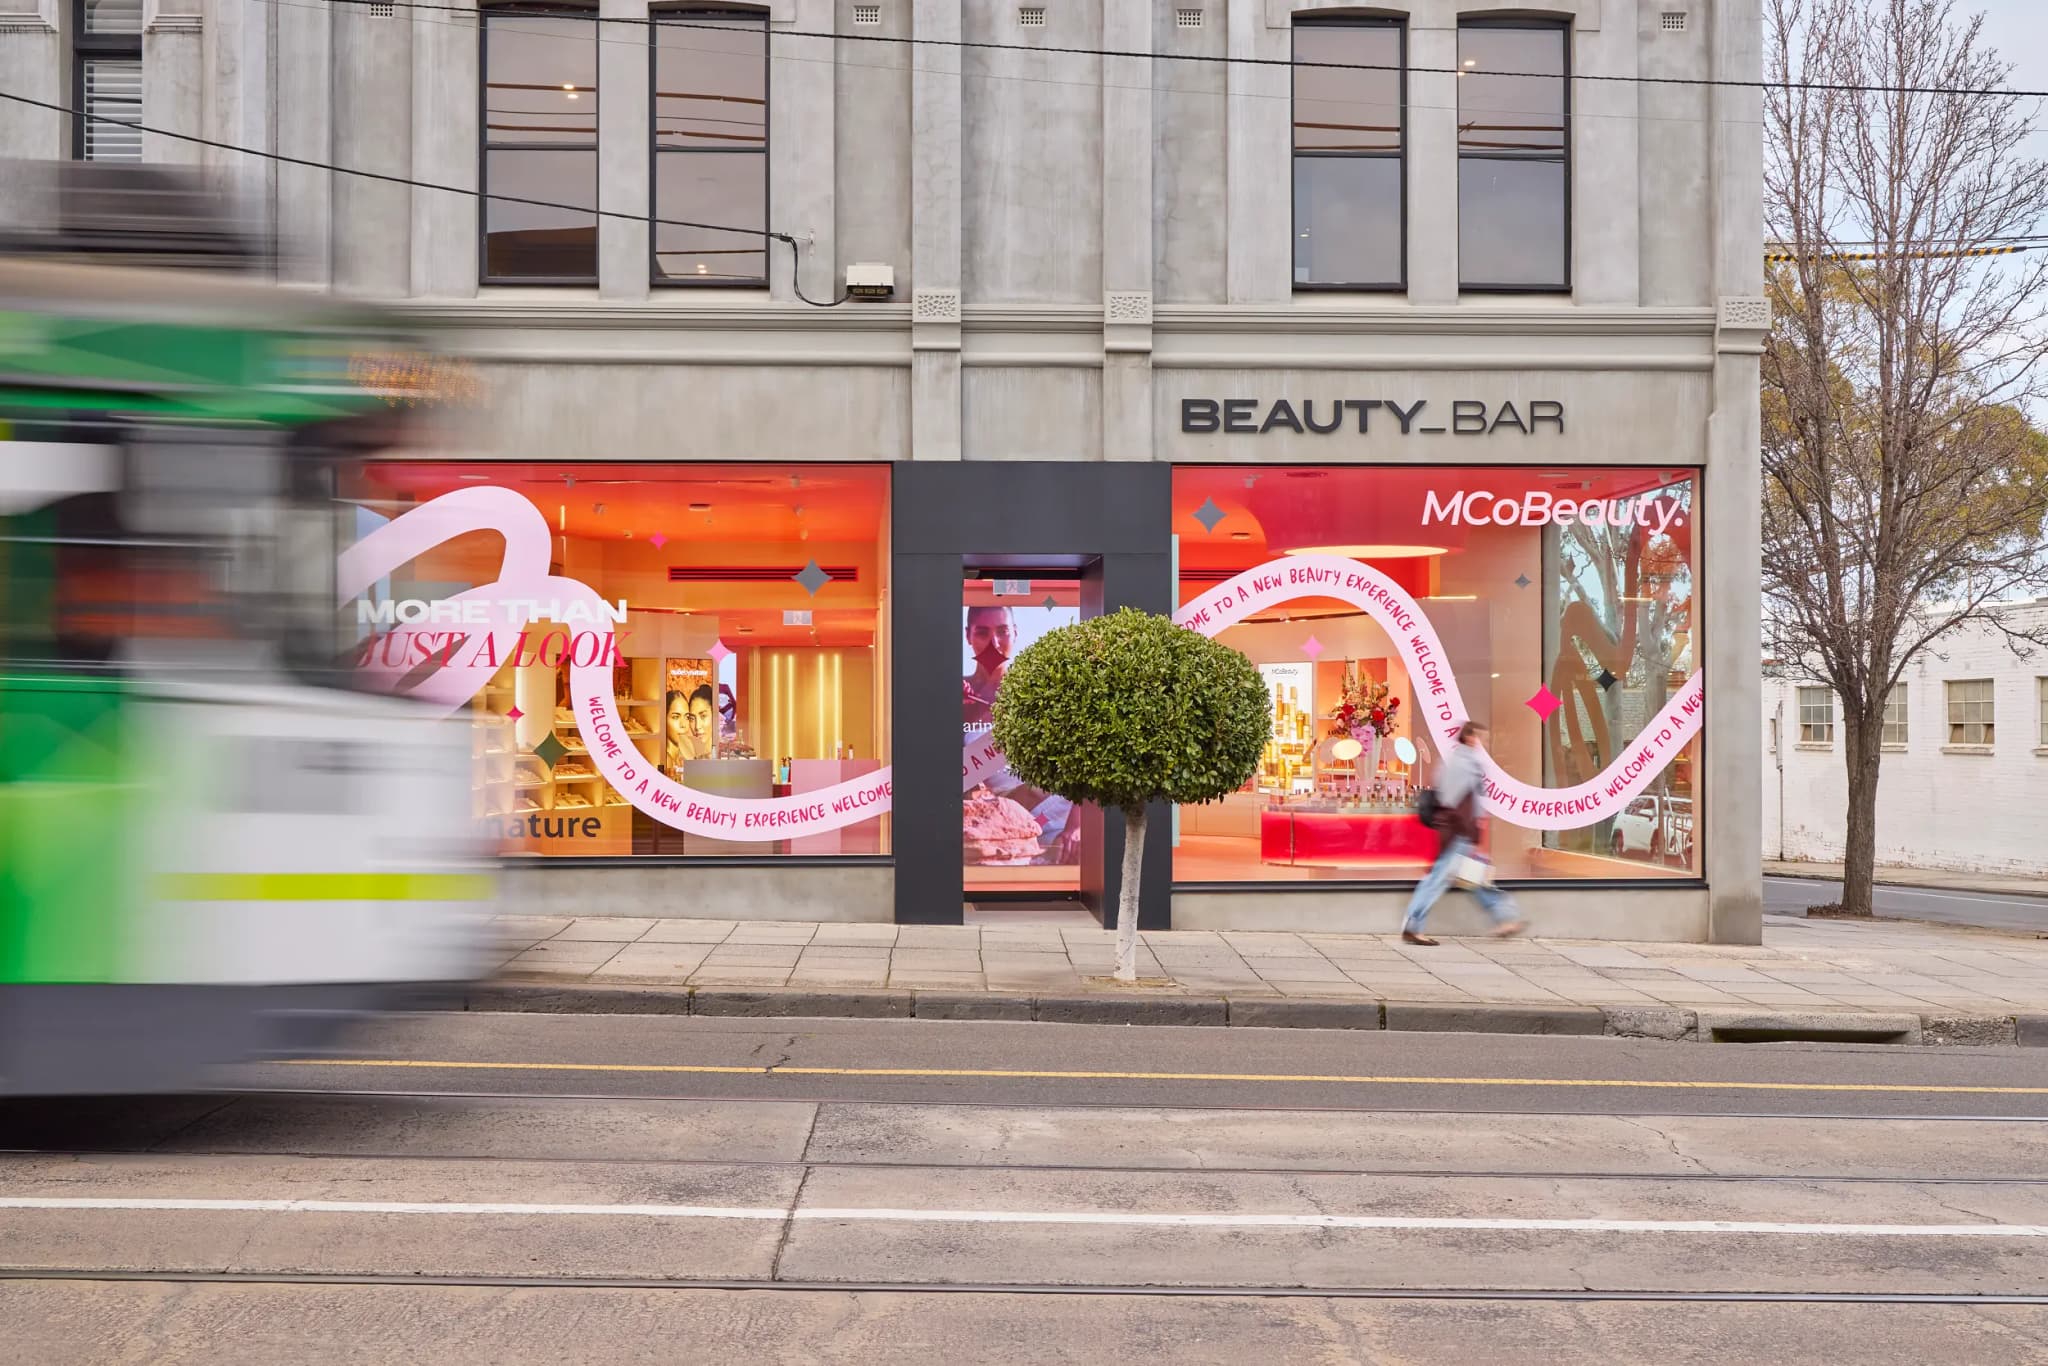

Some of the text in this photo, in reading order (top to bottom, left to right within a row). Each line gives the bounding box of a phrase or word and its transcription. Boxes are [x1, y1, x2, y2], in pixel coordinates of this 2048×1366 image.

[1181, 399, 1564, 434] BEAUTY_BAR
[1252, 573, 1282, 594] NEW
[1289, 566, 1342, 586] BEAUTY
[1214, 596, 1233, 615] TO
[1236, 585, 1250, 603] A
[1346, 573, 1417, 632] EXPERIENCE
[357, 599, 628, 624] MORE THAN
[357, 631, 632, 668] JUST A LOOK
[1410, 634, 1447, 696] WELCOME
[1436, 701, 1453, 721] TO
[1444, 725, 1461, 739] A
[588, 696, 892, 829] WELCOME TO A NEW BEAUTY EXPERIENCE WELCOME
[1521, 791, 1601, 818] EXPERIENCE
[1604, 745, 1655, 798] WELCOME
[1653, 728, 1673, 749] TO
[1669, 714, 1686, 731] A
